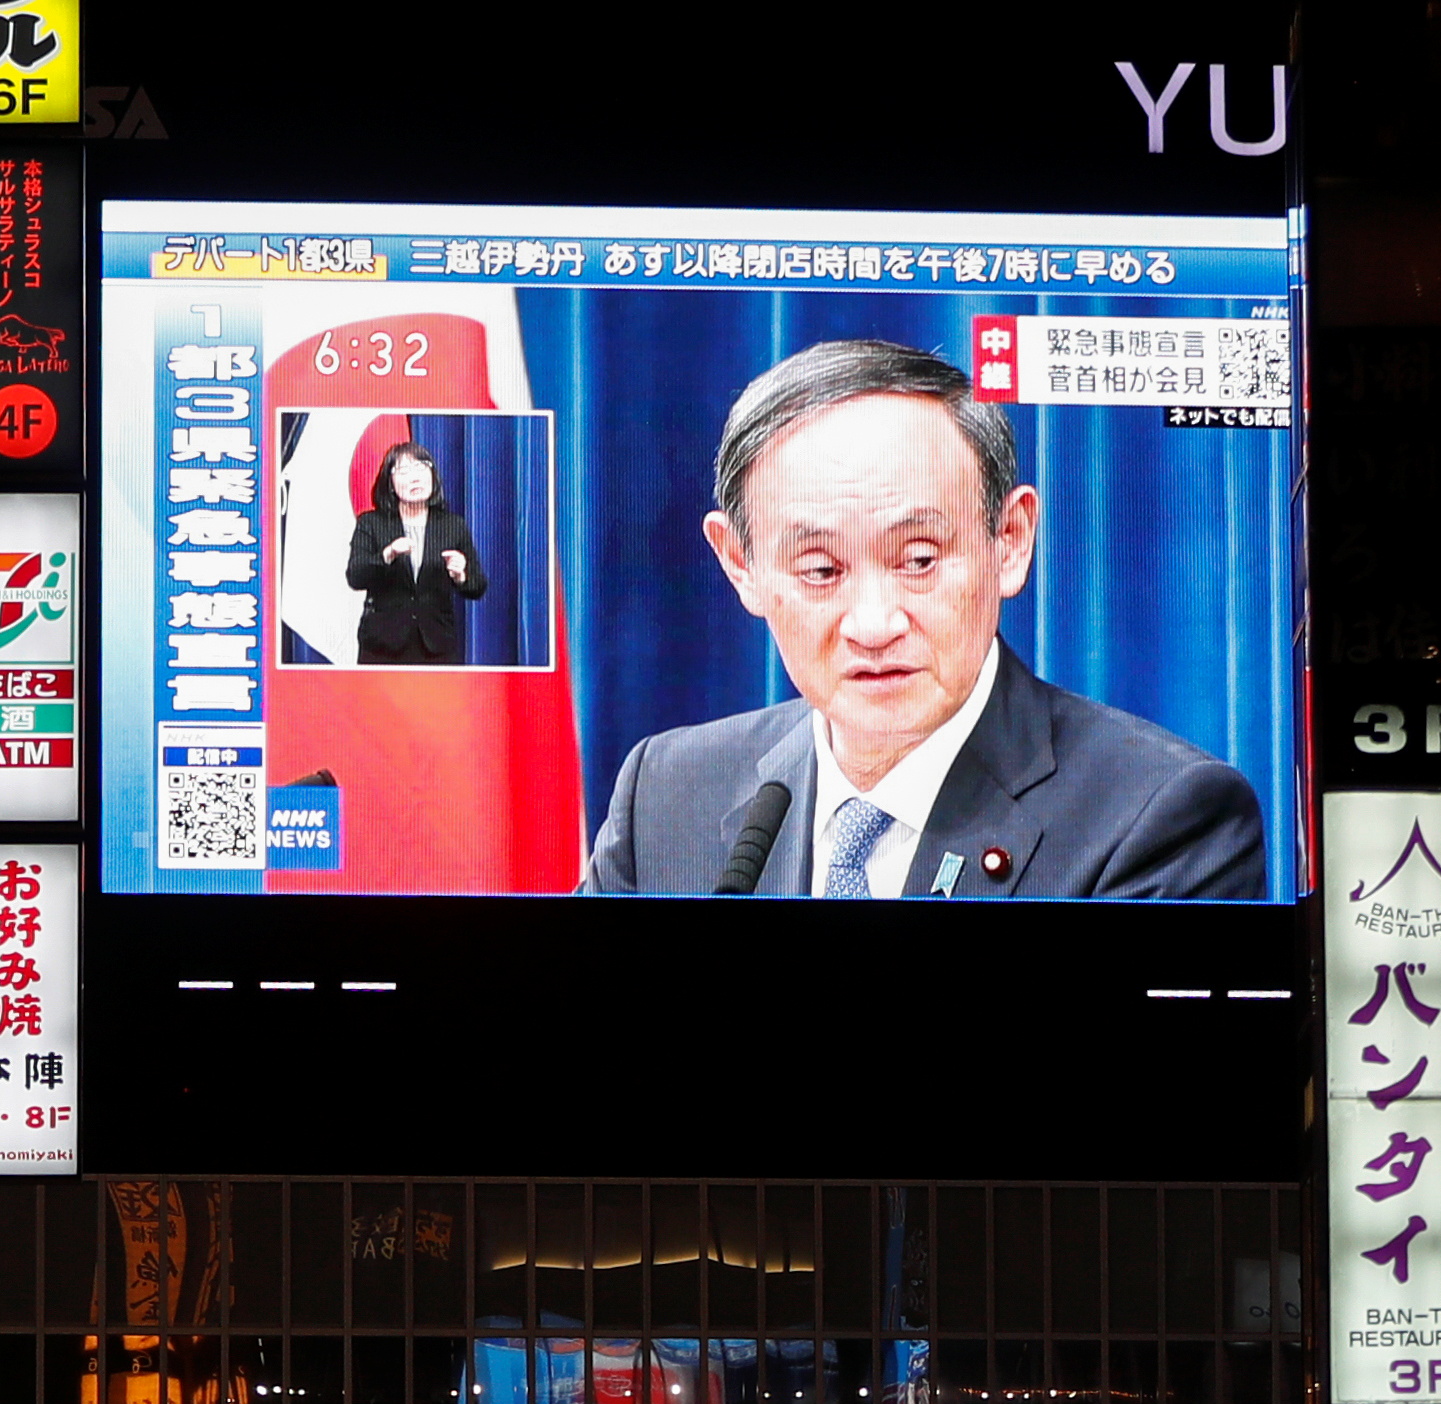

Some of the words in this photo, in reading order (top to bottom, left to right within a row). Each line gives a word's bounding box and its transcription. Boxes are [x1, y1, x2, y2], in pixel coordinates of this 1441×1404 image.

[1114, 61, 1287, 156] YU
[22, 158, 44, 289] 本格シュラスコ
[162, 237, 376, 275] デパート1都3県
[410, 240, 585, 277] 三越伊勢丹
[604, 242, 1178, 285] あす以降閉店時間を午後7時に早める
[314, 331, 430, 378] 6:32
[980, 327, 1013, 390] 中継
[1047, 327, 1207, 360] 緊急事態宣言
[1047, 366, 1207, 395] 菅首相が会見
[0, 705, 36, 732] 酒
[186, 747, 238, 766] 配信中
[271, 809, 327, 827] NHK
[265, 831, 332, 849] NEWS
[1347, 961, 1441, 1284] バンタイ
